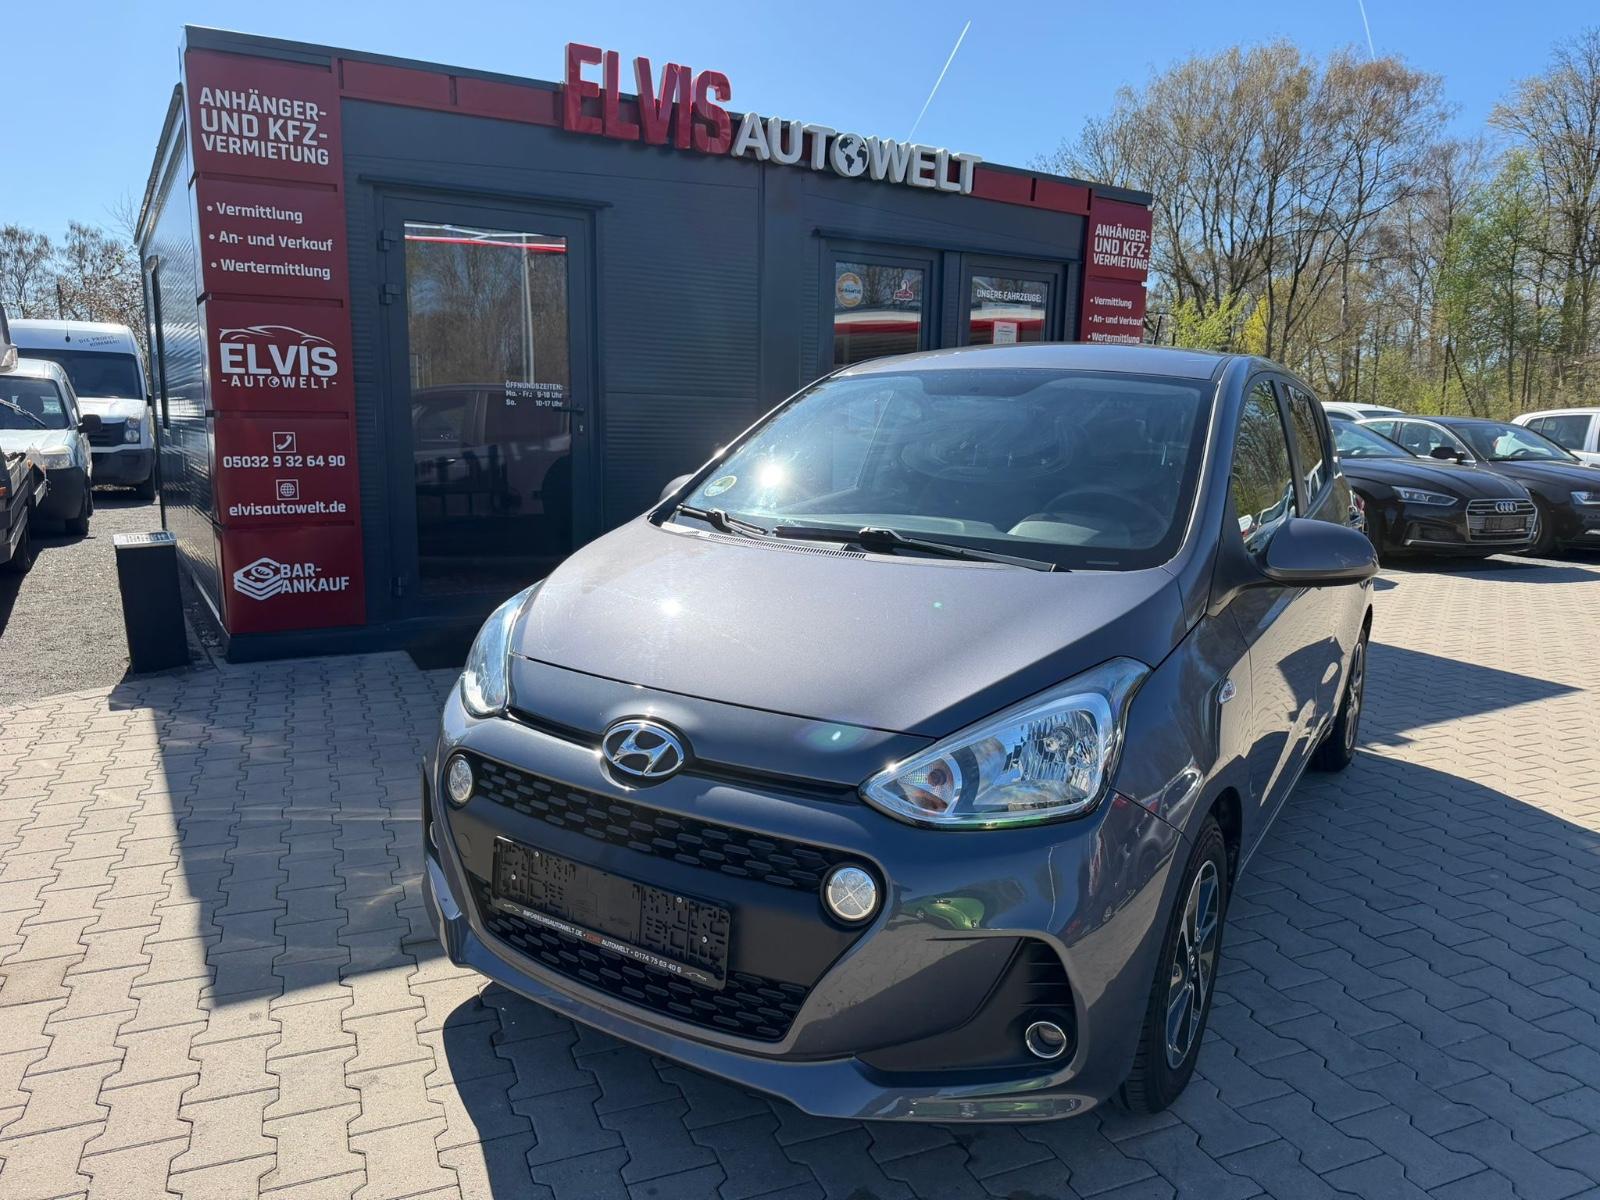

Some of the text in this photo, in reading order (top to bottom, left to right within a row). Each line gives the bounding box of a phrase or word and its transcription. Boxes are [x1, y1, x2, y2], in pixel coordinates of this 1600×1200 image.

[199, 87, 327, 121] ANHÄNGER-
[563, 42, 731, 154] ELVIS
[200, 107, 328, 146] UND KFZ-
[201, 133, 329, 165] VERMIETUNG
[216, 202, 303, 224] Vermittlung
[219, 230, 333, 251] An- und Verkauf
[1095, 224, 1149, 242] ANHÄNGER-
[1094, 237, 1149, 258] UND KFZ-
[220, 259, 331, 280] Wertermittlung
[1093, 253, 1148, 270] VERMIETUNG
[976, 289, 1003, 299] UNSERE
[1094, 296, 1132, 309] Vermittlung
[1105, 315, 1118, 324] und
[1119, 316, 1143, 326] Verkauf
[219, 342, 338, 377] ELVIS
[222, 455, 346, 468] 05032 9 32 64 90
[229, 501, 346, 516] elvisautowelt.de
[280, 563, 322, 578] BAR-
[280, 577, 350, 594] ANKAUF
